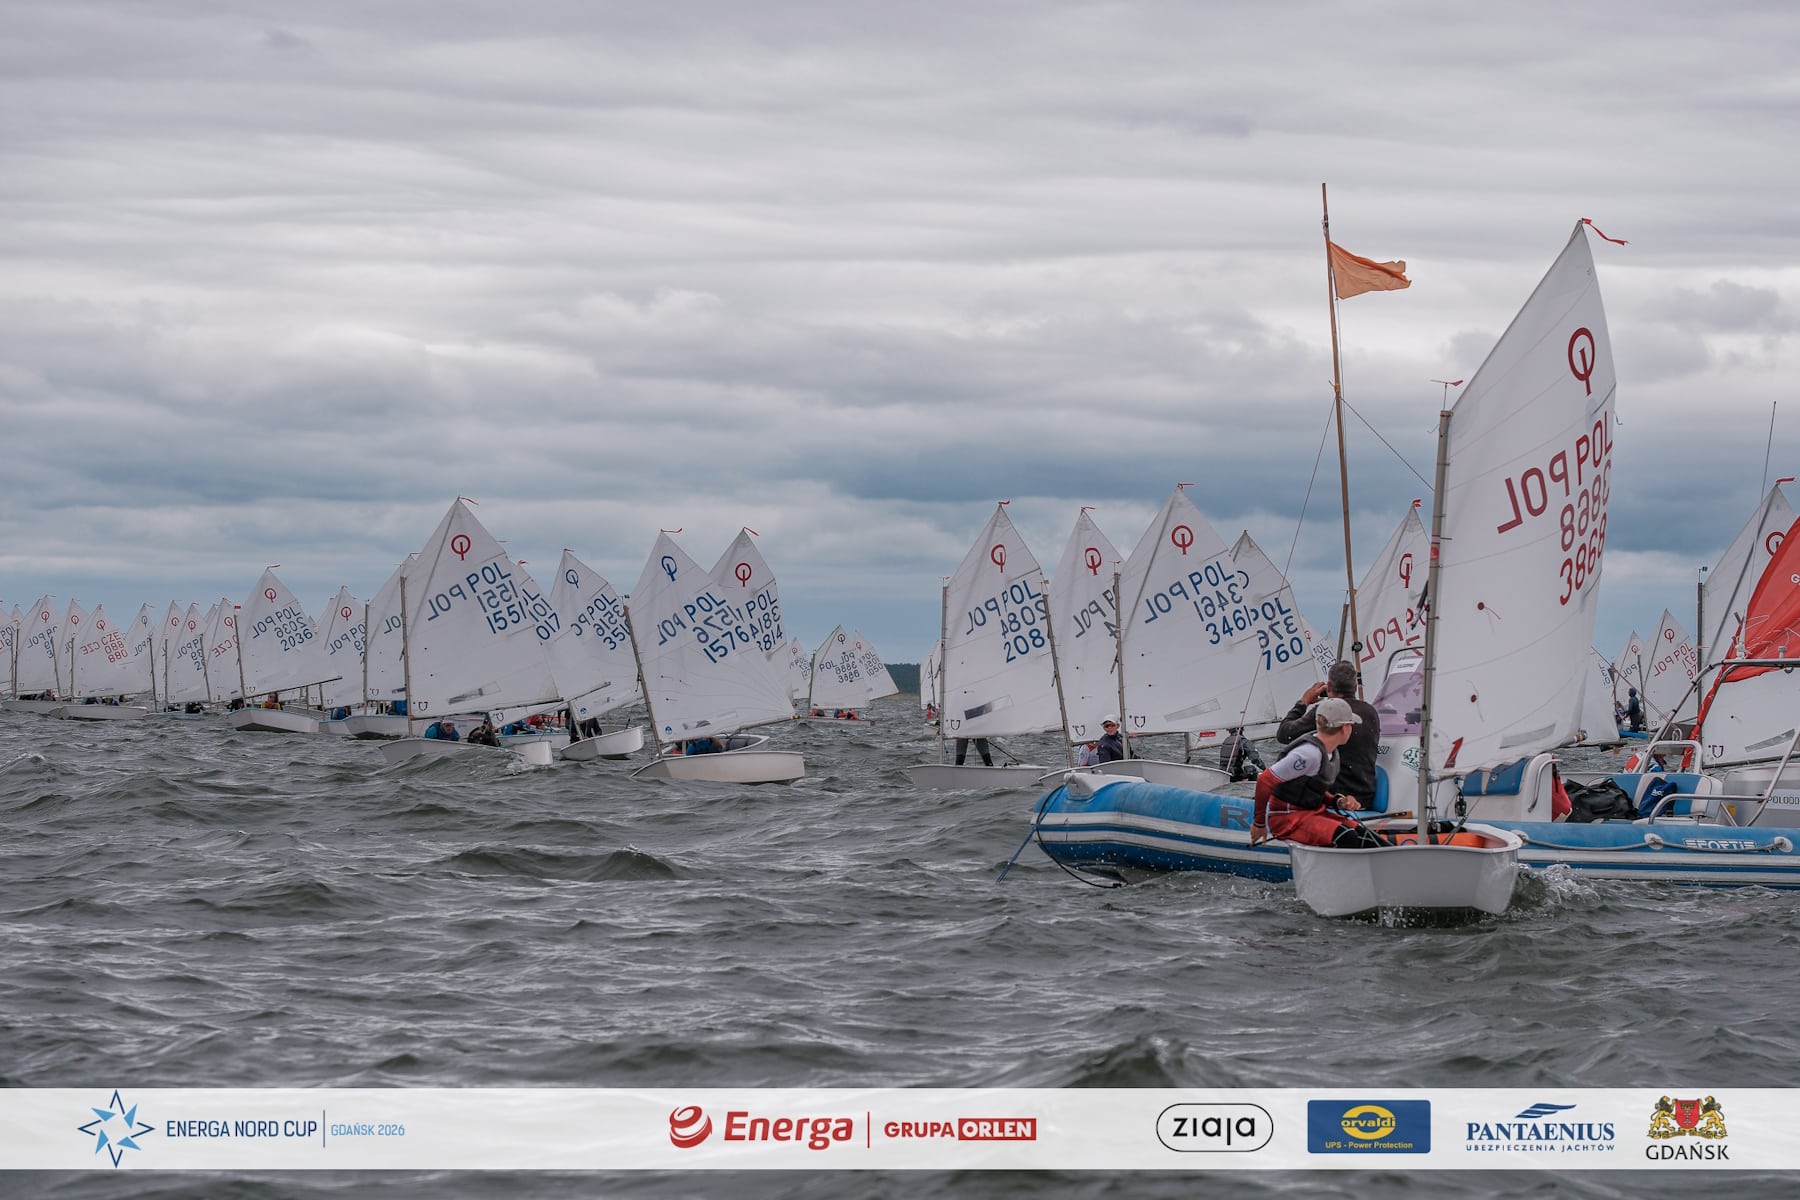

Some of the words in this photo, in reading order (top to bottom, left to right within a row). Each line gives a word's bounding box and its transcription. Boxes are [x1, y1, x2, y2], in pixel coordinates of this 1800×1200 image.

[1576, 411, 1613, 486] POL
[466, 562, 511, 593] POL
[1188, 561, 1235, 595] POL
[587, 594, 616, 620] POL
[684, 592, 726, 623] POL
[746, 589, 777, 619] POL
[1002, 580, 1042, 613] POL
[275, 606, 300, 622] POL
[486, 601, 527, 634] 1551
[536, 613, 560, 640] 017
[1206, 605, 1252, 645] 3461
[101, 631, 122, 646] CZE
[281, 629, 313, 651] 2036
[350, 624, 366, 639] PO
[703, 625, 749, 663] 1576
[1004, 628, 1046, 663] 208
[108, 649, 129, 663] 880
[1262, 637, 1303, 670] 760
[1686, 663, 1699, 679] 97
